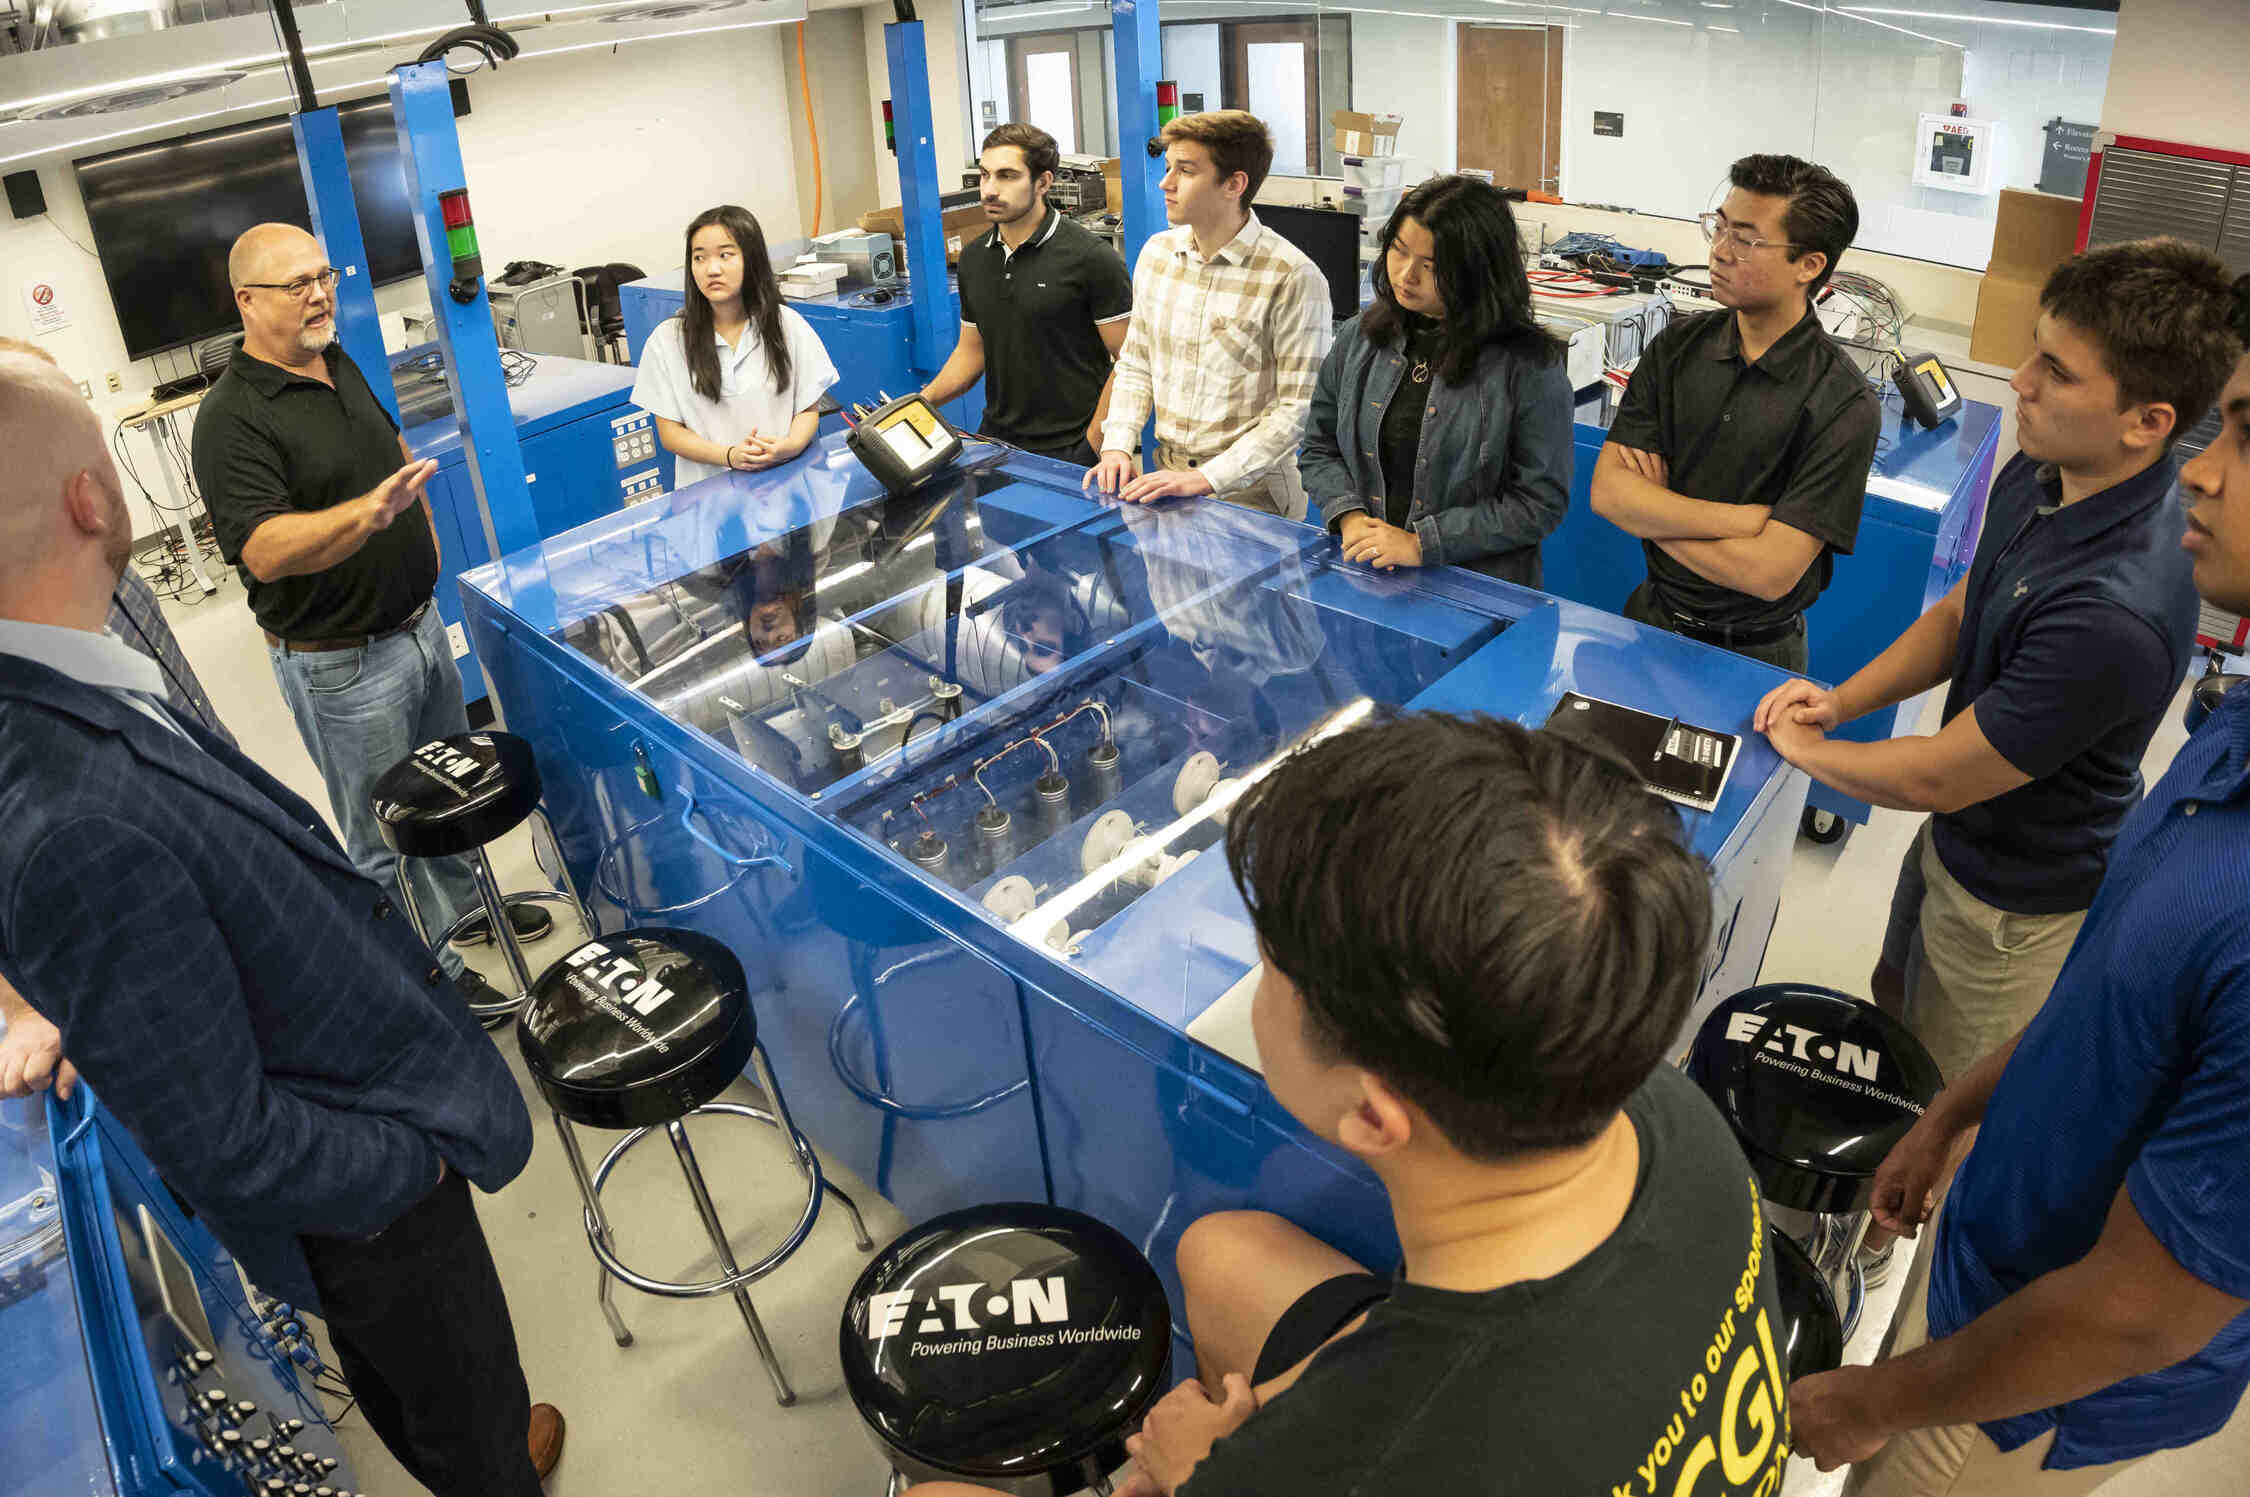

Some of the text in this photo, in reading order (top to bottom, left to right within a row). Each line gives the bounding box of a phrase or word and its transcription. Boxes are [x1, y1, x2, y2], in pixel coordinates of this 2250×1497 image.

[414, 740, 480, 778] EATON
[566, 943, 675, 1016] EATON
[625, 1016, 670, 1054] Worldwde
[1725, 1012, 1880, 1081] EATON
[1754, 1050, 1926, 1116] Powering Business Worldwide
[868, 1276, 1069, 1340] EATON
[911, 1324, 1142, 1357] Powering Business Worldwide
[1637, 1413, 1685, 1494] you
[1680, 1372, 1707, 1418] to
[1705, 1308, 1736, 1374] our
